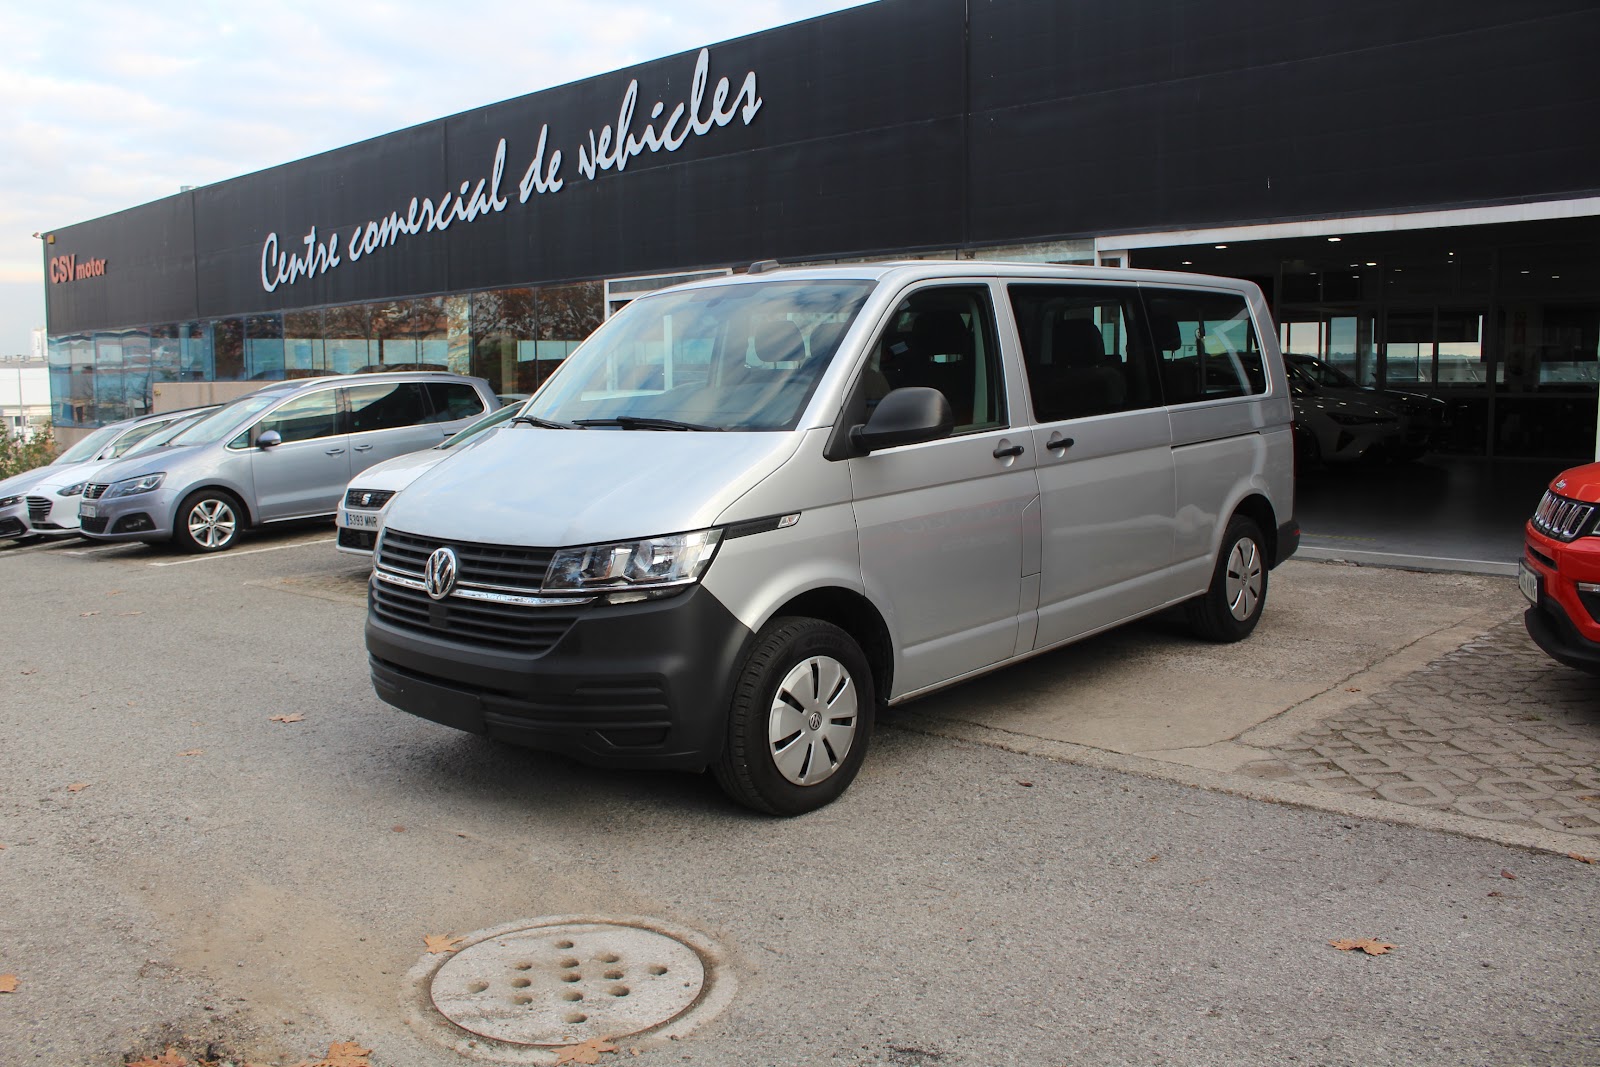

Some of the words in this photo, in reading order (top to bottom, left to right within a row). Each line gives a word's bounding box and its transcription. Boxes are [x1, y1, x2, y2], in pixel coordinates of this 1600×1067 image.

[261, 225, 339, 293] Centre
[348, 138, 507, 263] comercial
[519, 123, 563, 204] de
[578, 47, 763, 181] vehicles
[50, 253, 76, 284] CSV
[76, 257, 106, 280] motor
[349, 514, 364, 527] 5393
